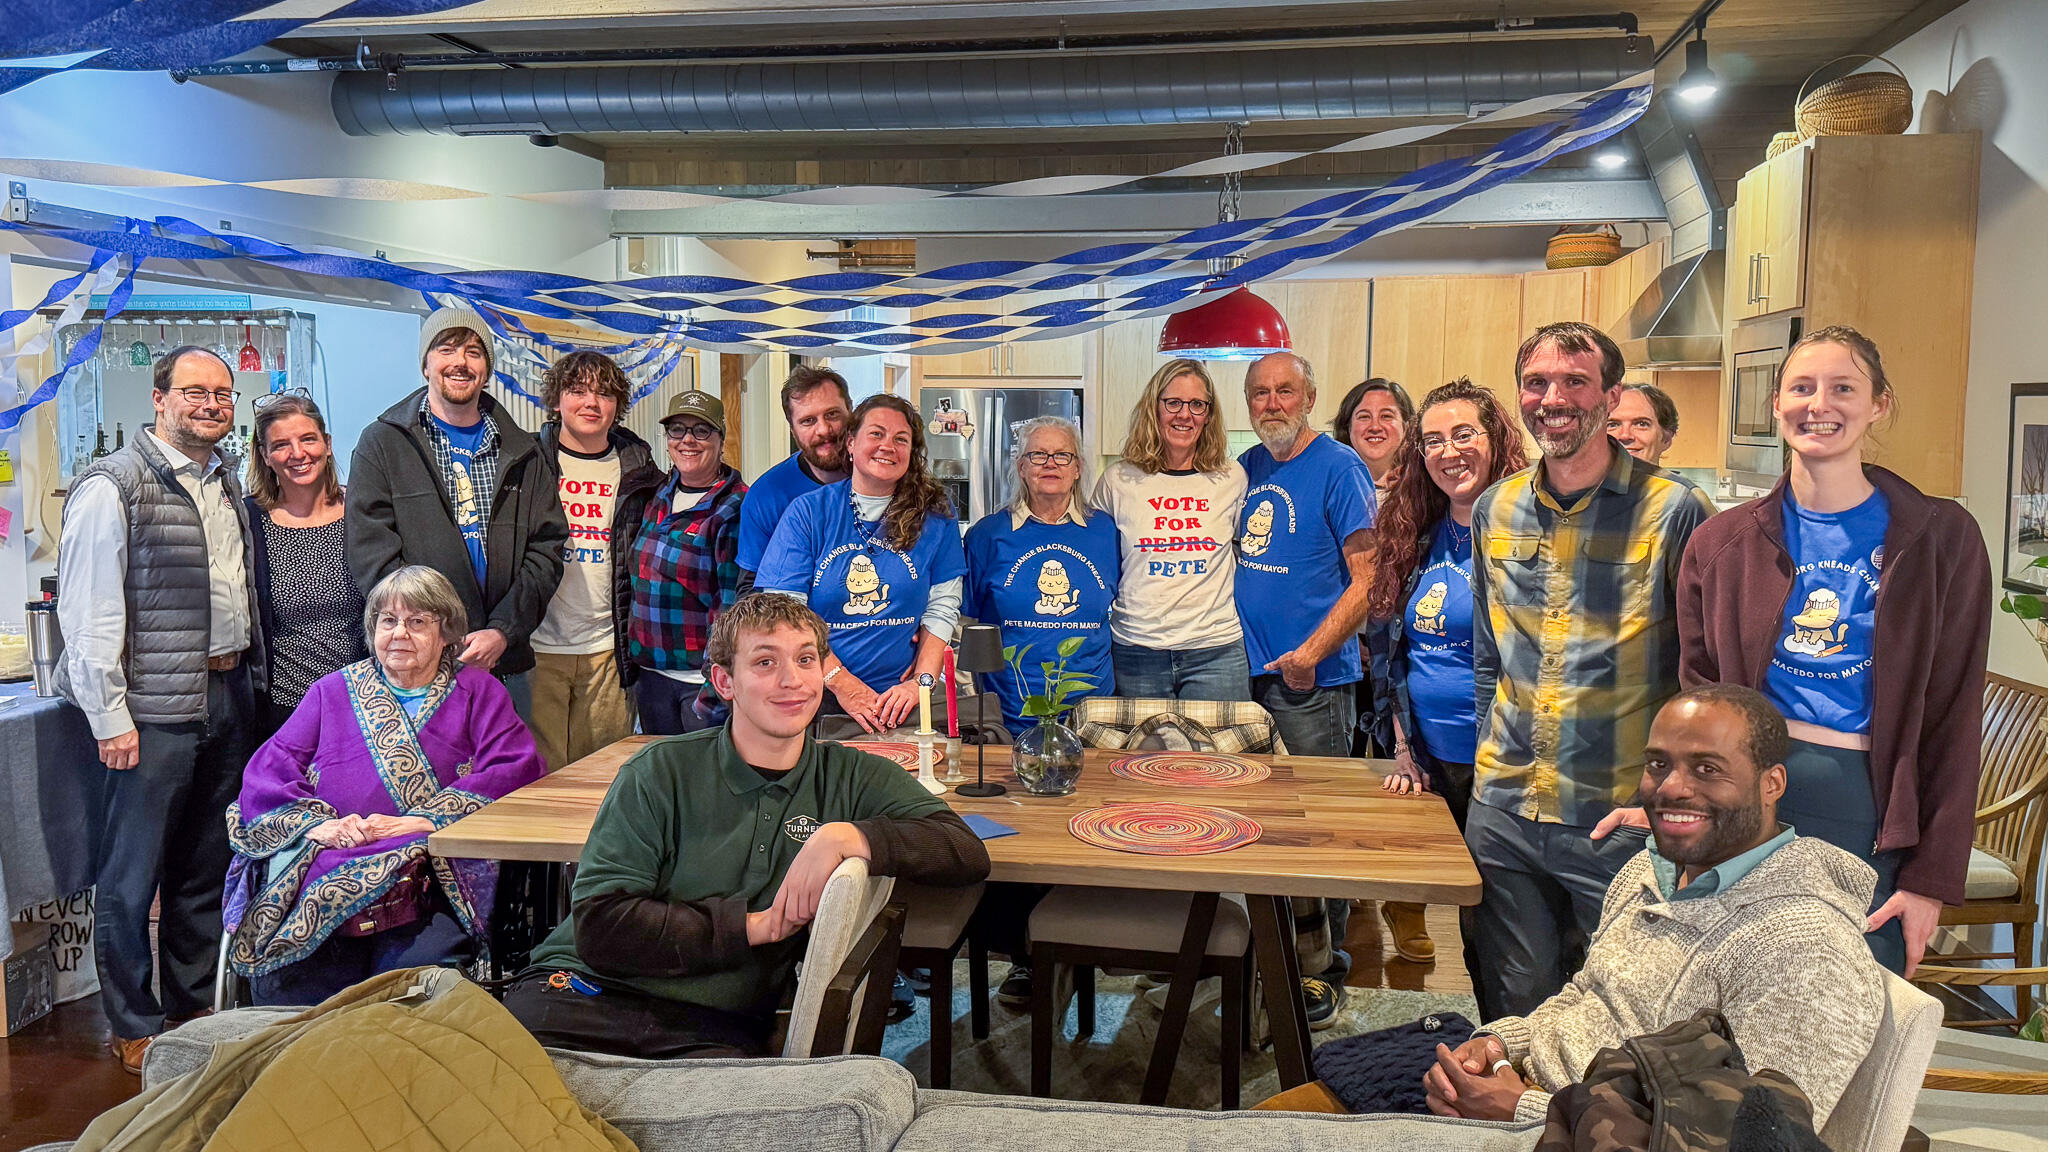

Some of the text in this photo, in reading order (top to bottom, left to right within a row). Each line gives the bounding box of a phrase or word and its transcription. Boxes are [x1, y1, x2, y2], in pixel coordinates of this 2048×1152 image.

[1148, 496, 1210, 512] VOTE
[1153, 516, 1202, 531] FOR
[569, 523, 612, 542] DRO
[1138, 536, 1217, 553] PEDRO
[562, 547, 605, 564] ETE
[813, 570, 823, 588] THE
[820, 544, 850, 570] CHANGE
[1003, 573, 1016, 588] THE
[1010, 550, 1037, 574] CHANGE
[1036, 543, 1088, 563] BLACKSBURG
[1147, 559, 1208, 578] PETE
[1248, 562, 1262, 571] FOR
[1261, 563, 1290, 575] MAYOR
[1817, 559, 1858, 575] KNEADS
[870, 620, 887, 628] FOR
[888, 616, 915, 627] MAYOR
[1004, 619, 1023, 628] PETE
[1023, 620, 1060, 630] MACEDO
[1061, 621, 1079, 630] FOR
[1771, 655, 1873, 680] MACEDO FOR MAYO
[49, 918, 93, 949] ROW
[51, 946, 84, 973] UP
